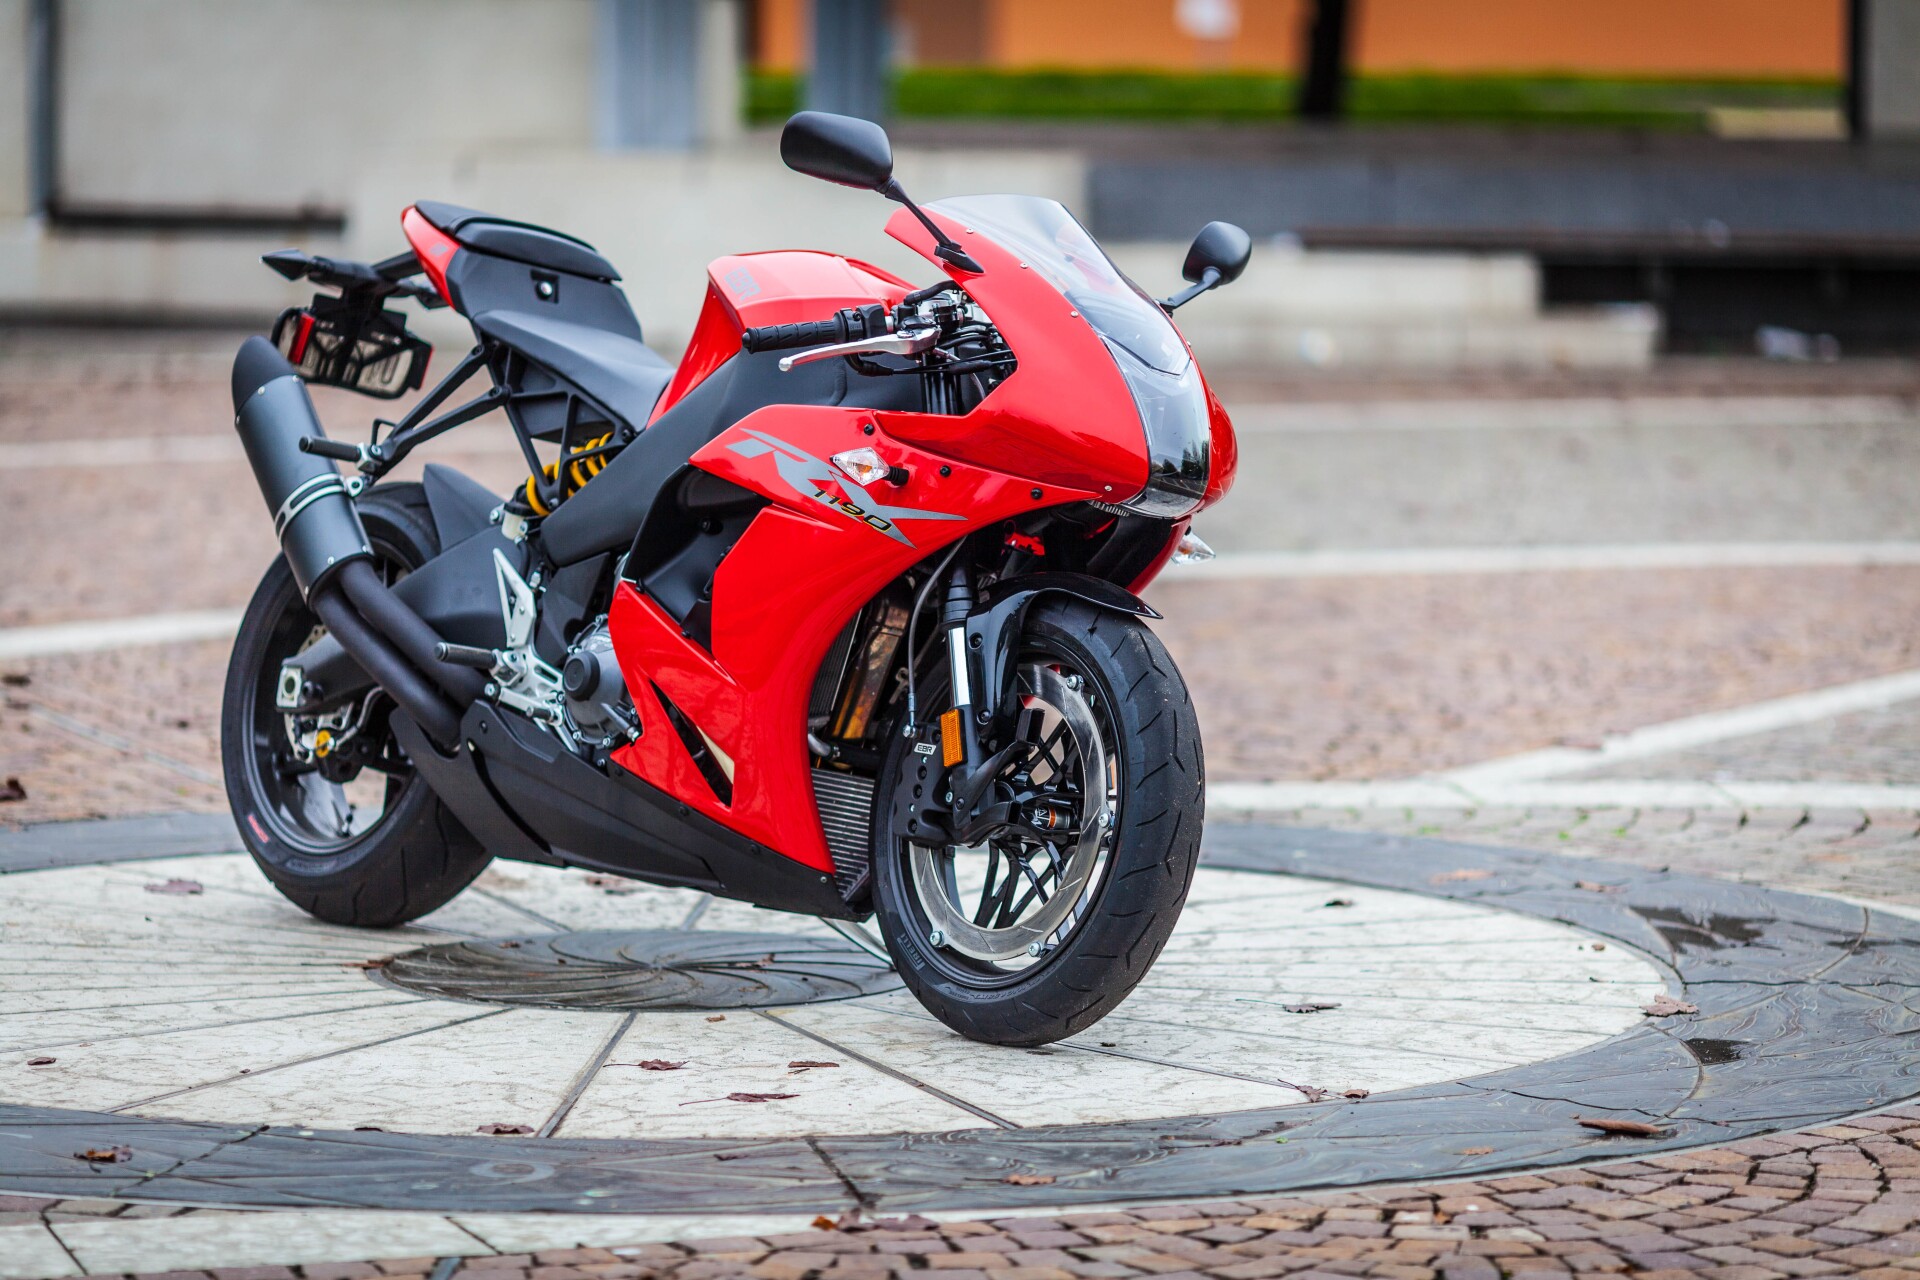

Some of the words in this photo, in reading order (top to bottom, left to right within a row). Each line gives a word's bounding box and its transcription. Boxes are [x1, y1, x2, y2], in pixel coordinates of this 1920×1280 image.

[724, 267, 762, 301] EBR
[813, 487, 893, 533] 1190
[917, 744, 933, 754] EBR
[897, 933, 926, 971] PIRELLI
